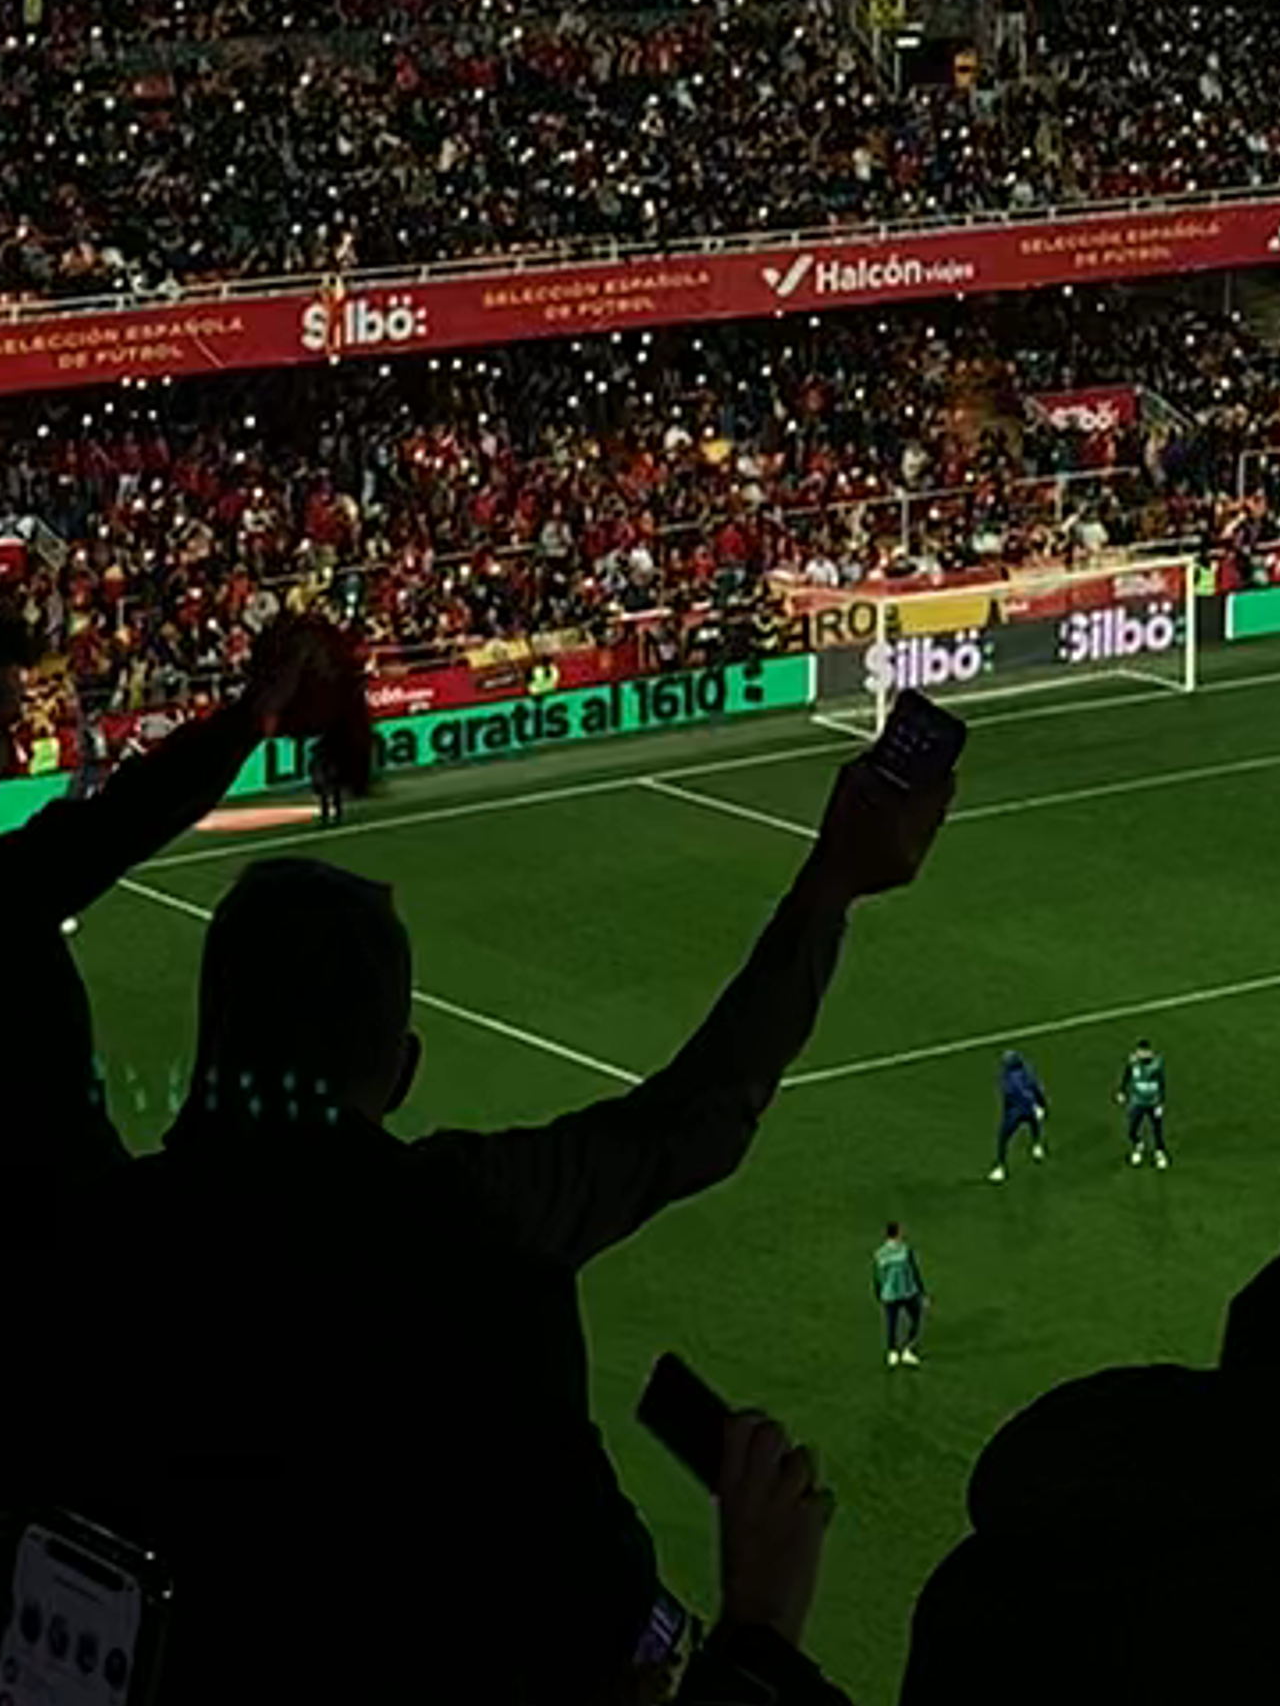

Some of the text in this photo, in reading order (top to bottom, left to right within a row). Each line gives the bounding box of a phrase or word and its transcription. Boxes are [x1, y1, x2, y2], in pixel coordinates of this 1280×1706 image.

[815, 252, 922, 295] Halcón
[432, 696, 571, 760] gratis
[581, 680, 619, 727] al
[629, 668, 726, 721] 1610
